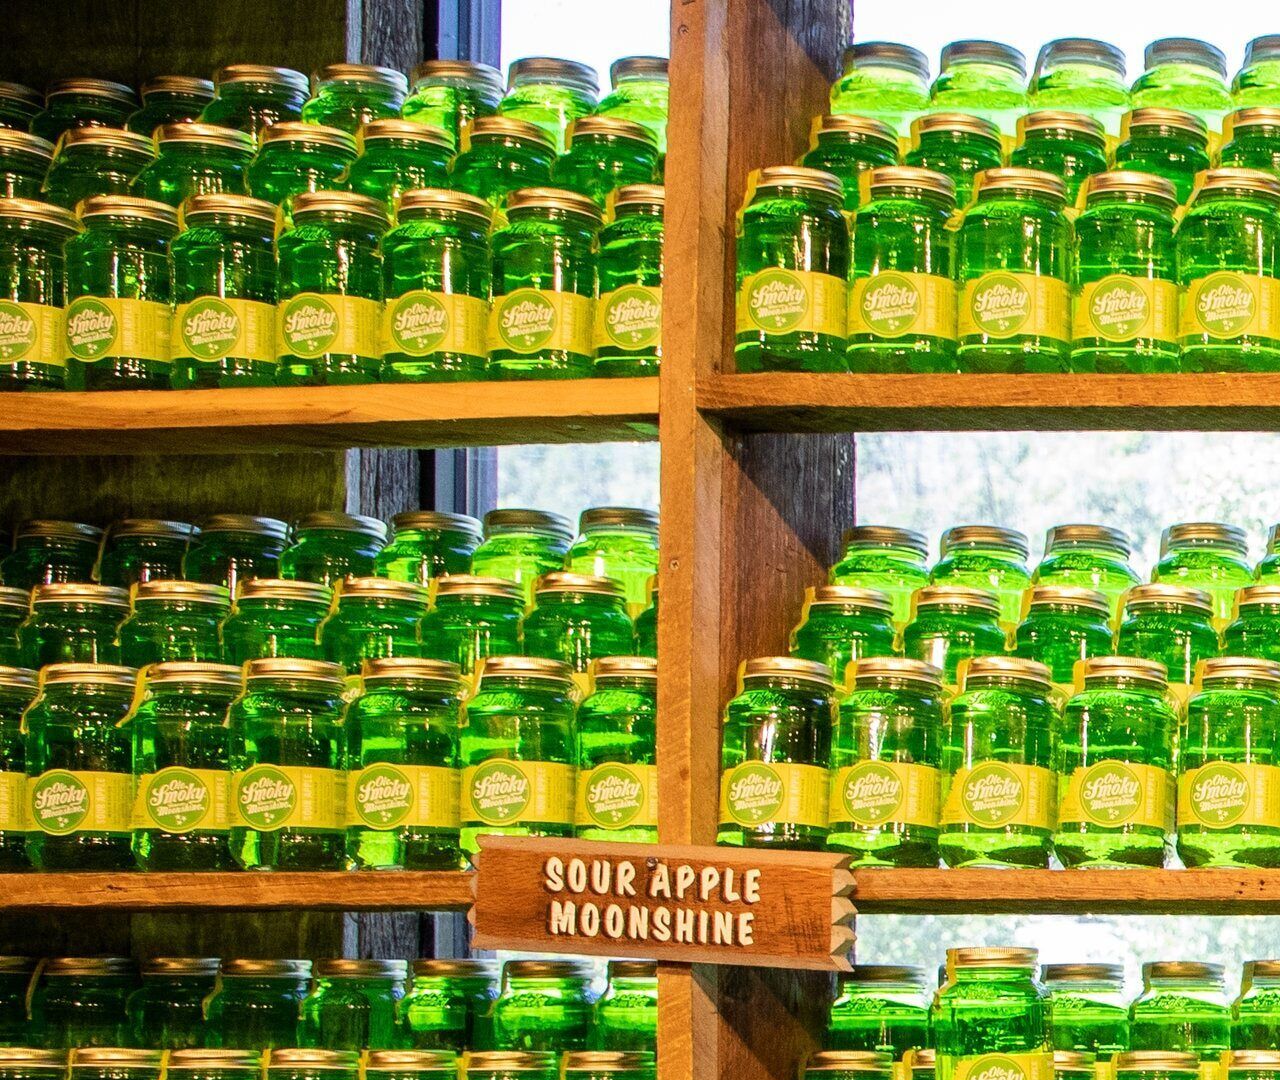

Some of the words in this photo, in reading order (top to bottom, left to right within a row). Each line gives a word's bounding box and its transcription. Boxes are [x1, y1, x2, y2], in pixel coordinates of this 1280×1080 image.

[863, 287, 919, 310] Smoky
[1094, 291, 1147, 314] Smoky
[502, 305, 555, 327] Smoky
[150, 783, 207, 806] Smoky
[966, 777, 1022, 800] Smoky
[546, 856, 636, 896] SOUR
[651, 864, 761, 903] APPLE
[551, 900, 754, 946] MOONSHINE
[988, 1067, 1007, 1078] Ole
